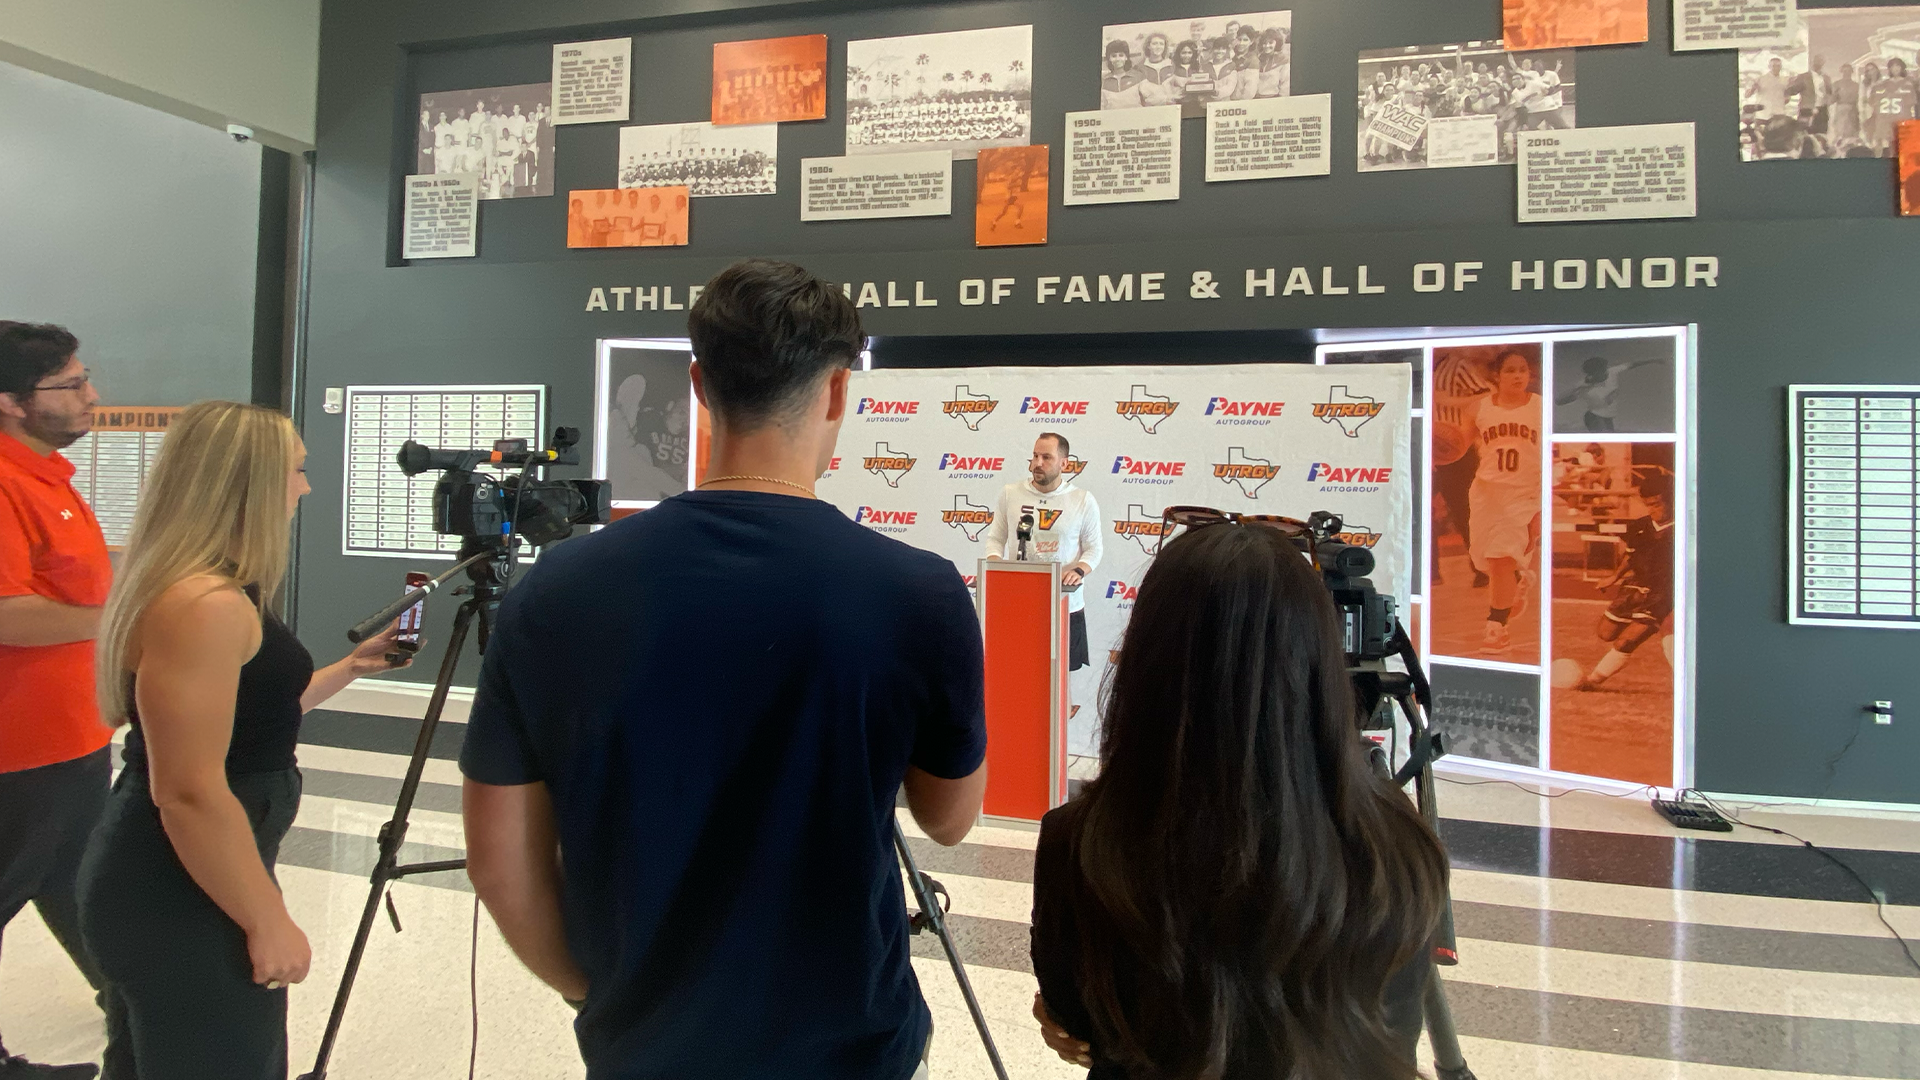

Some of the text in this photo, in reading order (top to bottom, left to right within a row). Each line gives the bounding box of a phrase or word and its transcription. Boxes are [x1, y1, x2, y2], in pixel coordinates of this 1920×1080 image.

[1215, 109, 1246, 117] 2000s
[1879, 98, 1902, 113] 25
[1074, 119, 1101, 127] 1990s
[1384, 104, 1426, 132] WAC
[1370, 121, 1417, 146] CHAMPIONS
[959, 278, 1015, 306] OF
[1036, 272, 1165, 304] FAME
[1190, 271, 1220, 299] &
[1245, 265, 1386, 298] HALL
[1413, 261, 1483, 292] OF
[1511, 256, 1719, 291] HONOR
[857, 398, 919, 414] PAYNE
[942, 400, 999, 413] UTRGV
[1019, 396, 1090, 415] PAYNE
[1115, 401, 1180, 416] UTRGV
[1204, 397, 1286, 416] PAYNE
[1311, 402, 1386, 418] UTRGV
[92, 412, 180, 427] AMPION
[1483, 423, 1537, 445] BRONCS
[863, 457, 918, 470] UTRGV
[939, 453, 1005, 471] PAYNE
[1111, 456, 1186, 476] PAYNE
[1496, 449, 1519, 472] 10
[1212, 463, 1281, 479] UTRGV
[1307, 462, 1393, 483] PAYNE
[855, 506, 918, 525] PAYNE
[941, 510, 994, 524] UTRGV
[1036, 508, 1063, 530] V
[1112, 520, 1178, 537] UTRGV
